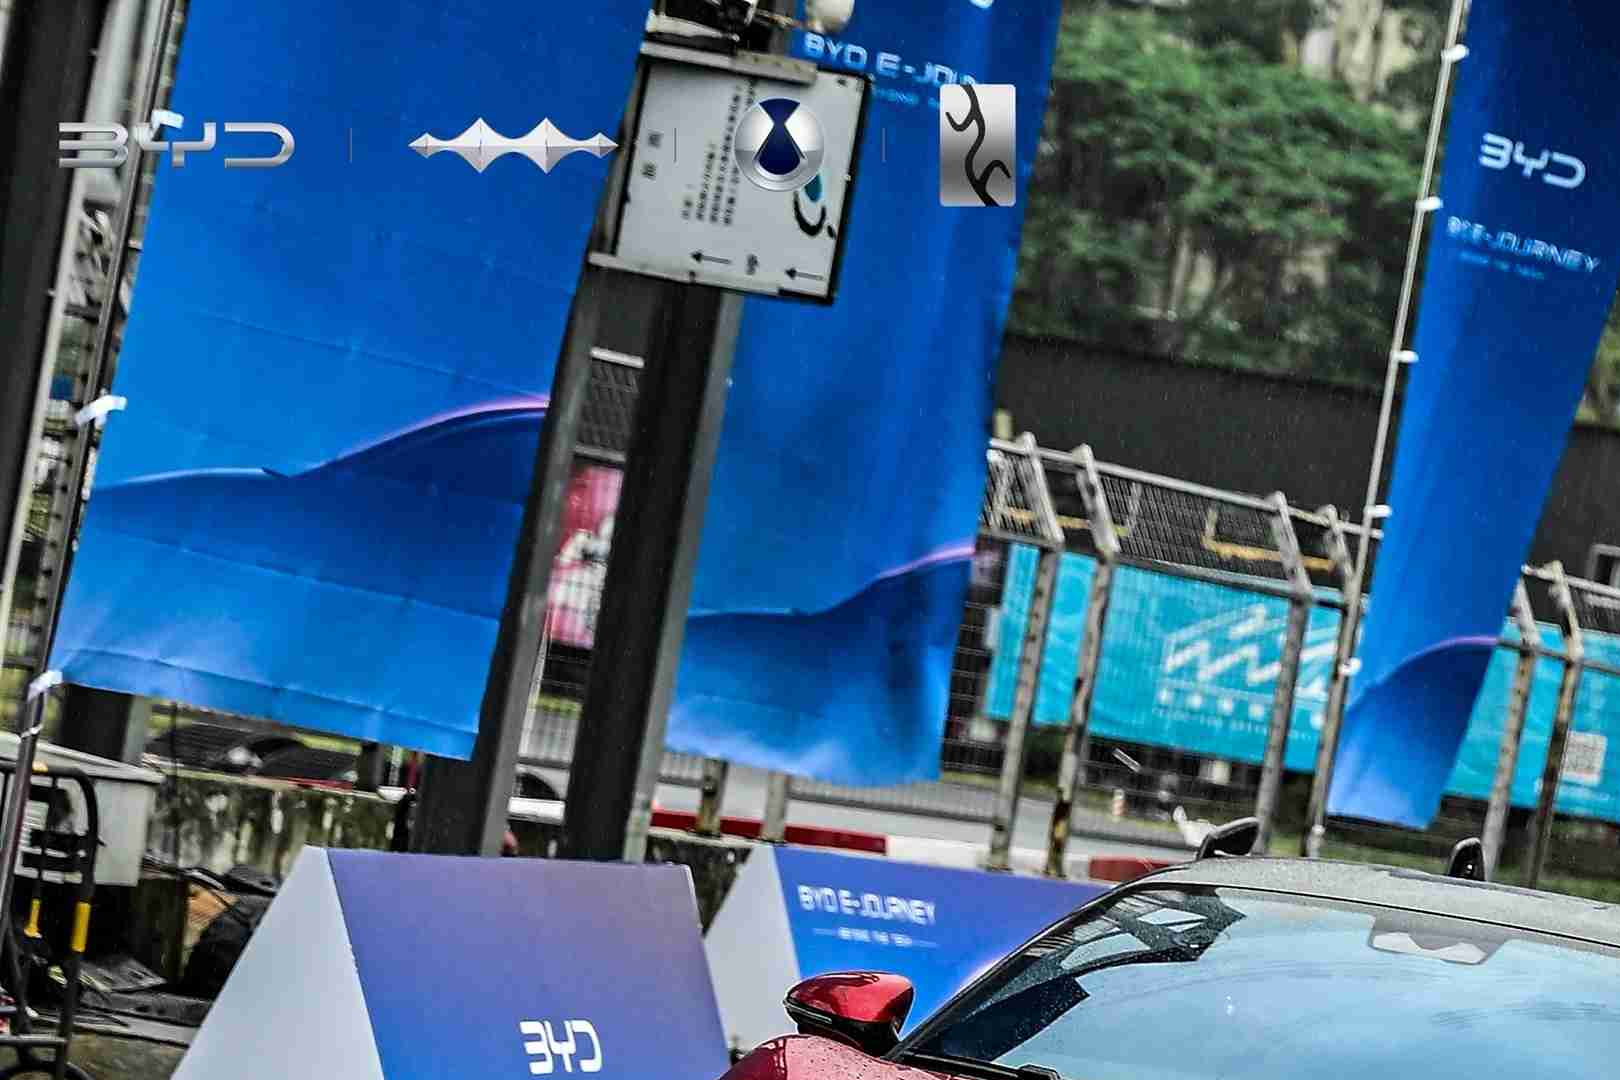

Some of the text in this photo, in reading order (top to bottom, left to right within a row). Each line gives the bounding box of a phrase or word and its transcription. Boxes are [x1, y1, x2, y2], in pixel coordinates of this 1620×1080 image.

[804, 31, 868, 72] BYD
[1478, 132, 1587, 189] BYD
[797, 884, 937, 926] BYD E-JOURNEY
[519, 1019, 603, 1075] BYD
